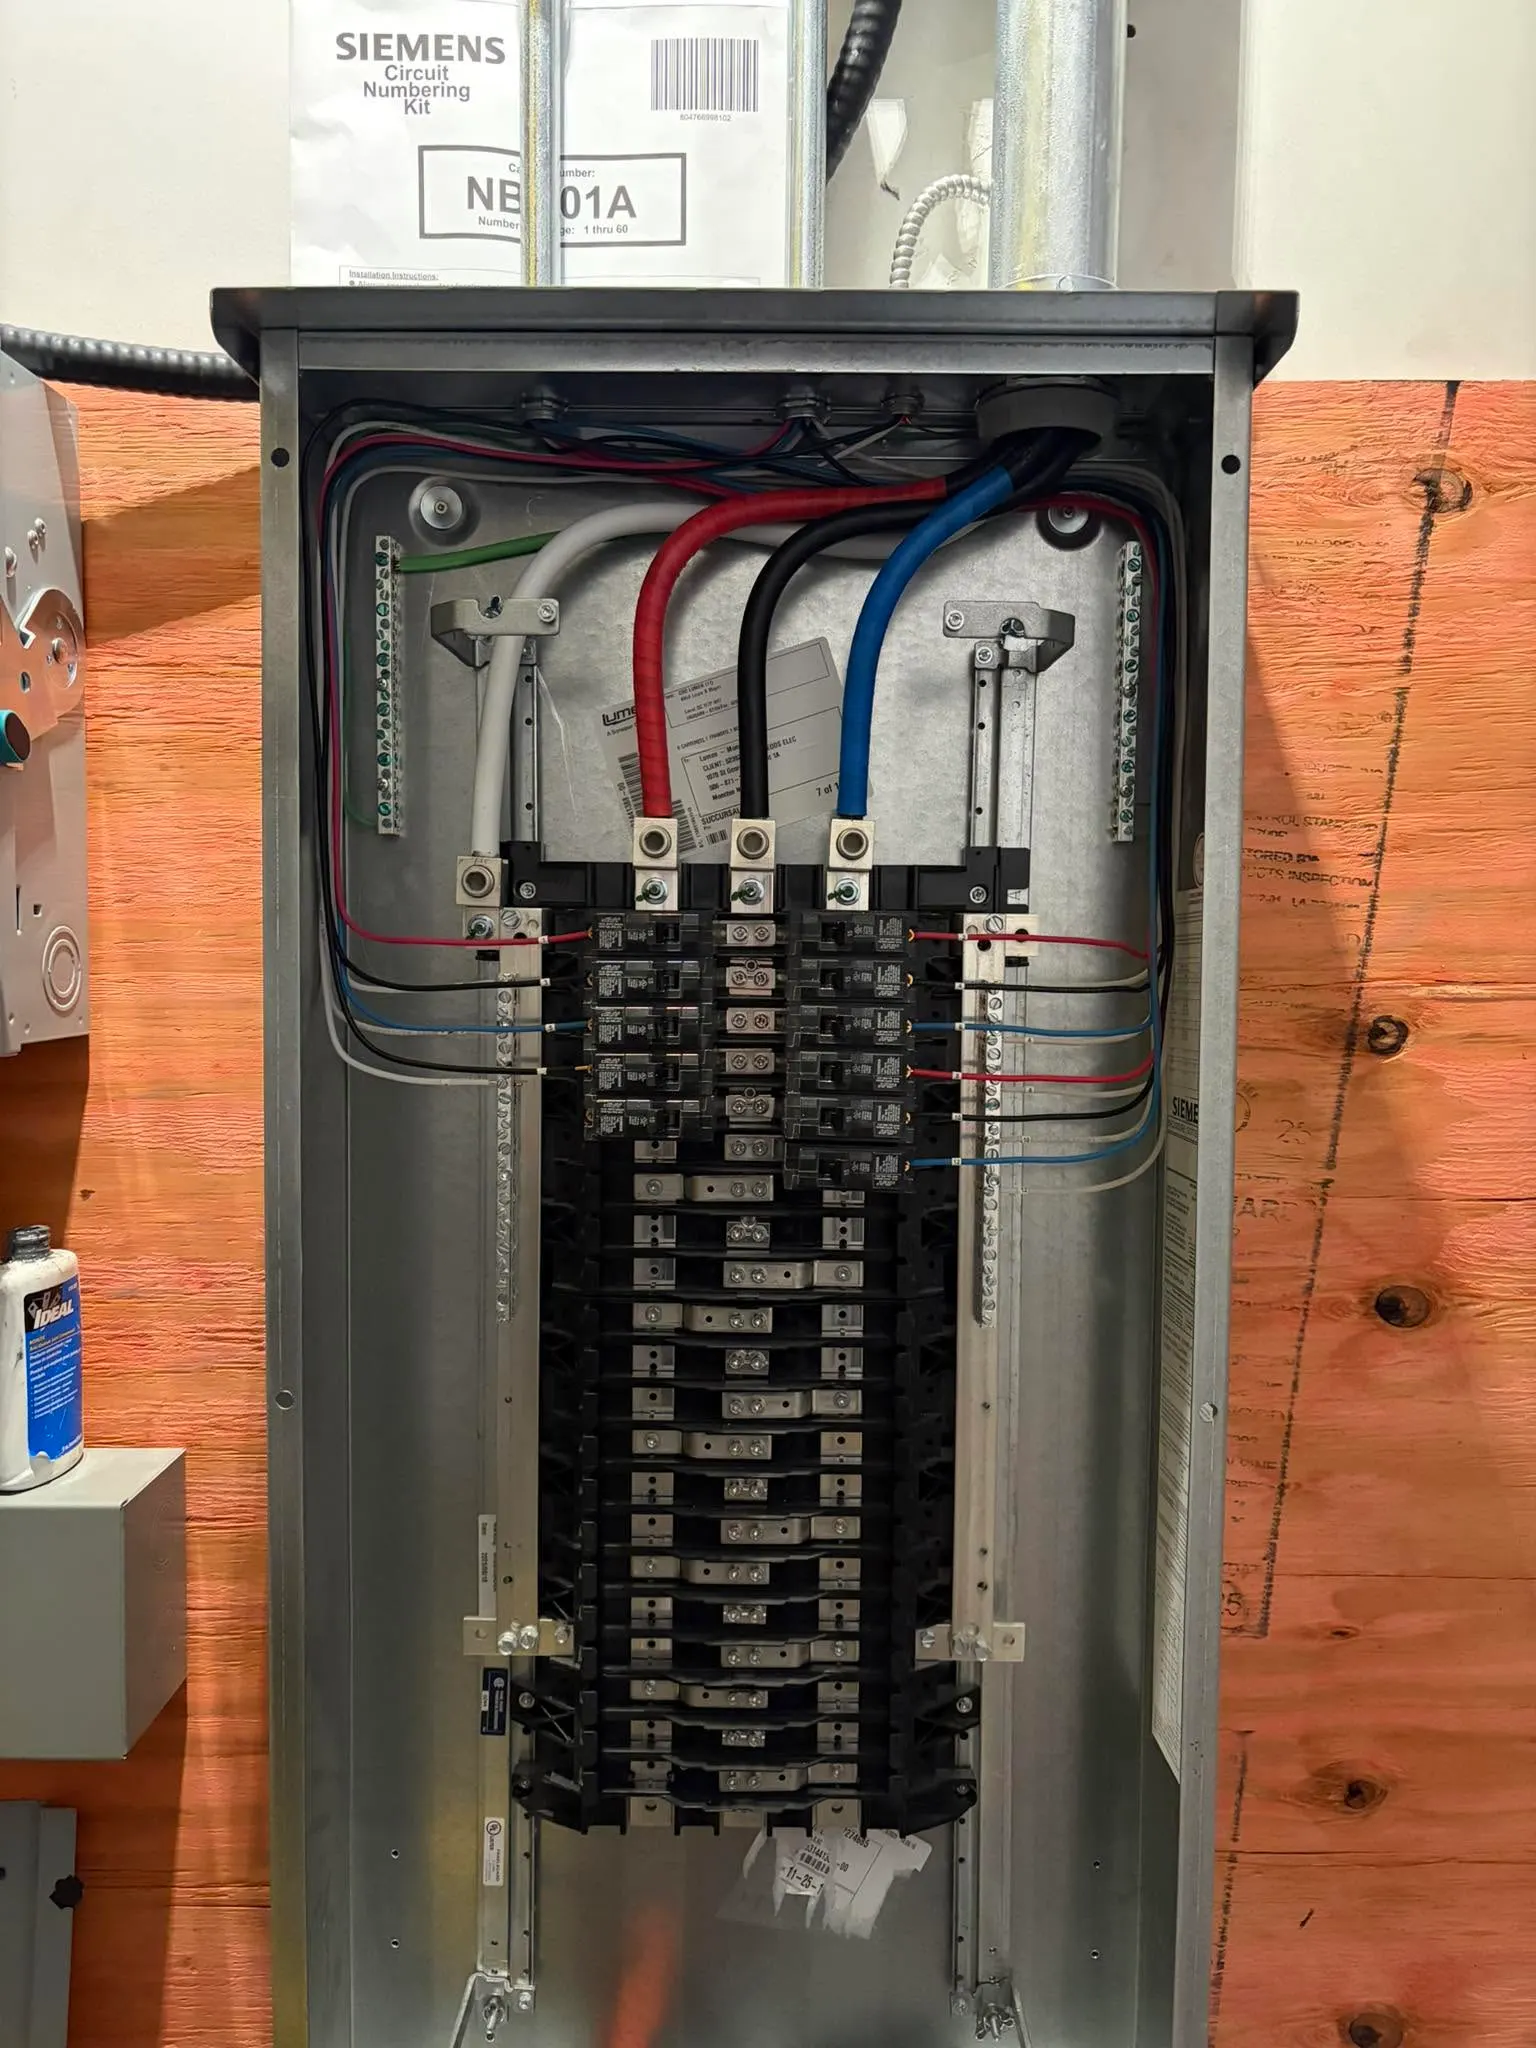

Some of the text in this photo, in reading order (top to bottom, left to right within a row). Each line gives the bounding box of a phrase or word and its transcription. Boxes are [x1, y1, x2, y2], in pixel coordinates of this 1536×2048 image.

[336, 32, 506, 64] SIEMENS
[385, 64, 449, 81] Circuit
[363, 81, 471, 102] Numbering
[404, 99, 431, 115] Kit
[560, 168, 595, 178] umber:
[467, 175, 637, 220] NB01A
[478, 216, 520, 230] Number
[584, 225, 589, 233] 1
[593, 224, 613, 234] thru
[616, 224, 628, 234] 60
[349, 270, 391, 280] Installation
[816, 787, 821, 797] 7
[824, 783, 833, 794] of
[701, 807, 741, 825] SUCCURSAL
[1172, 1096, 1199, 1124] SIEME
[33, 1299, 74, 1330] IDEAL
